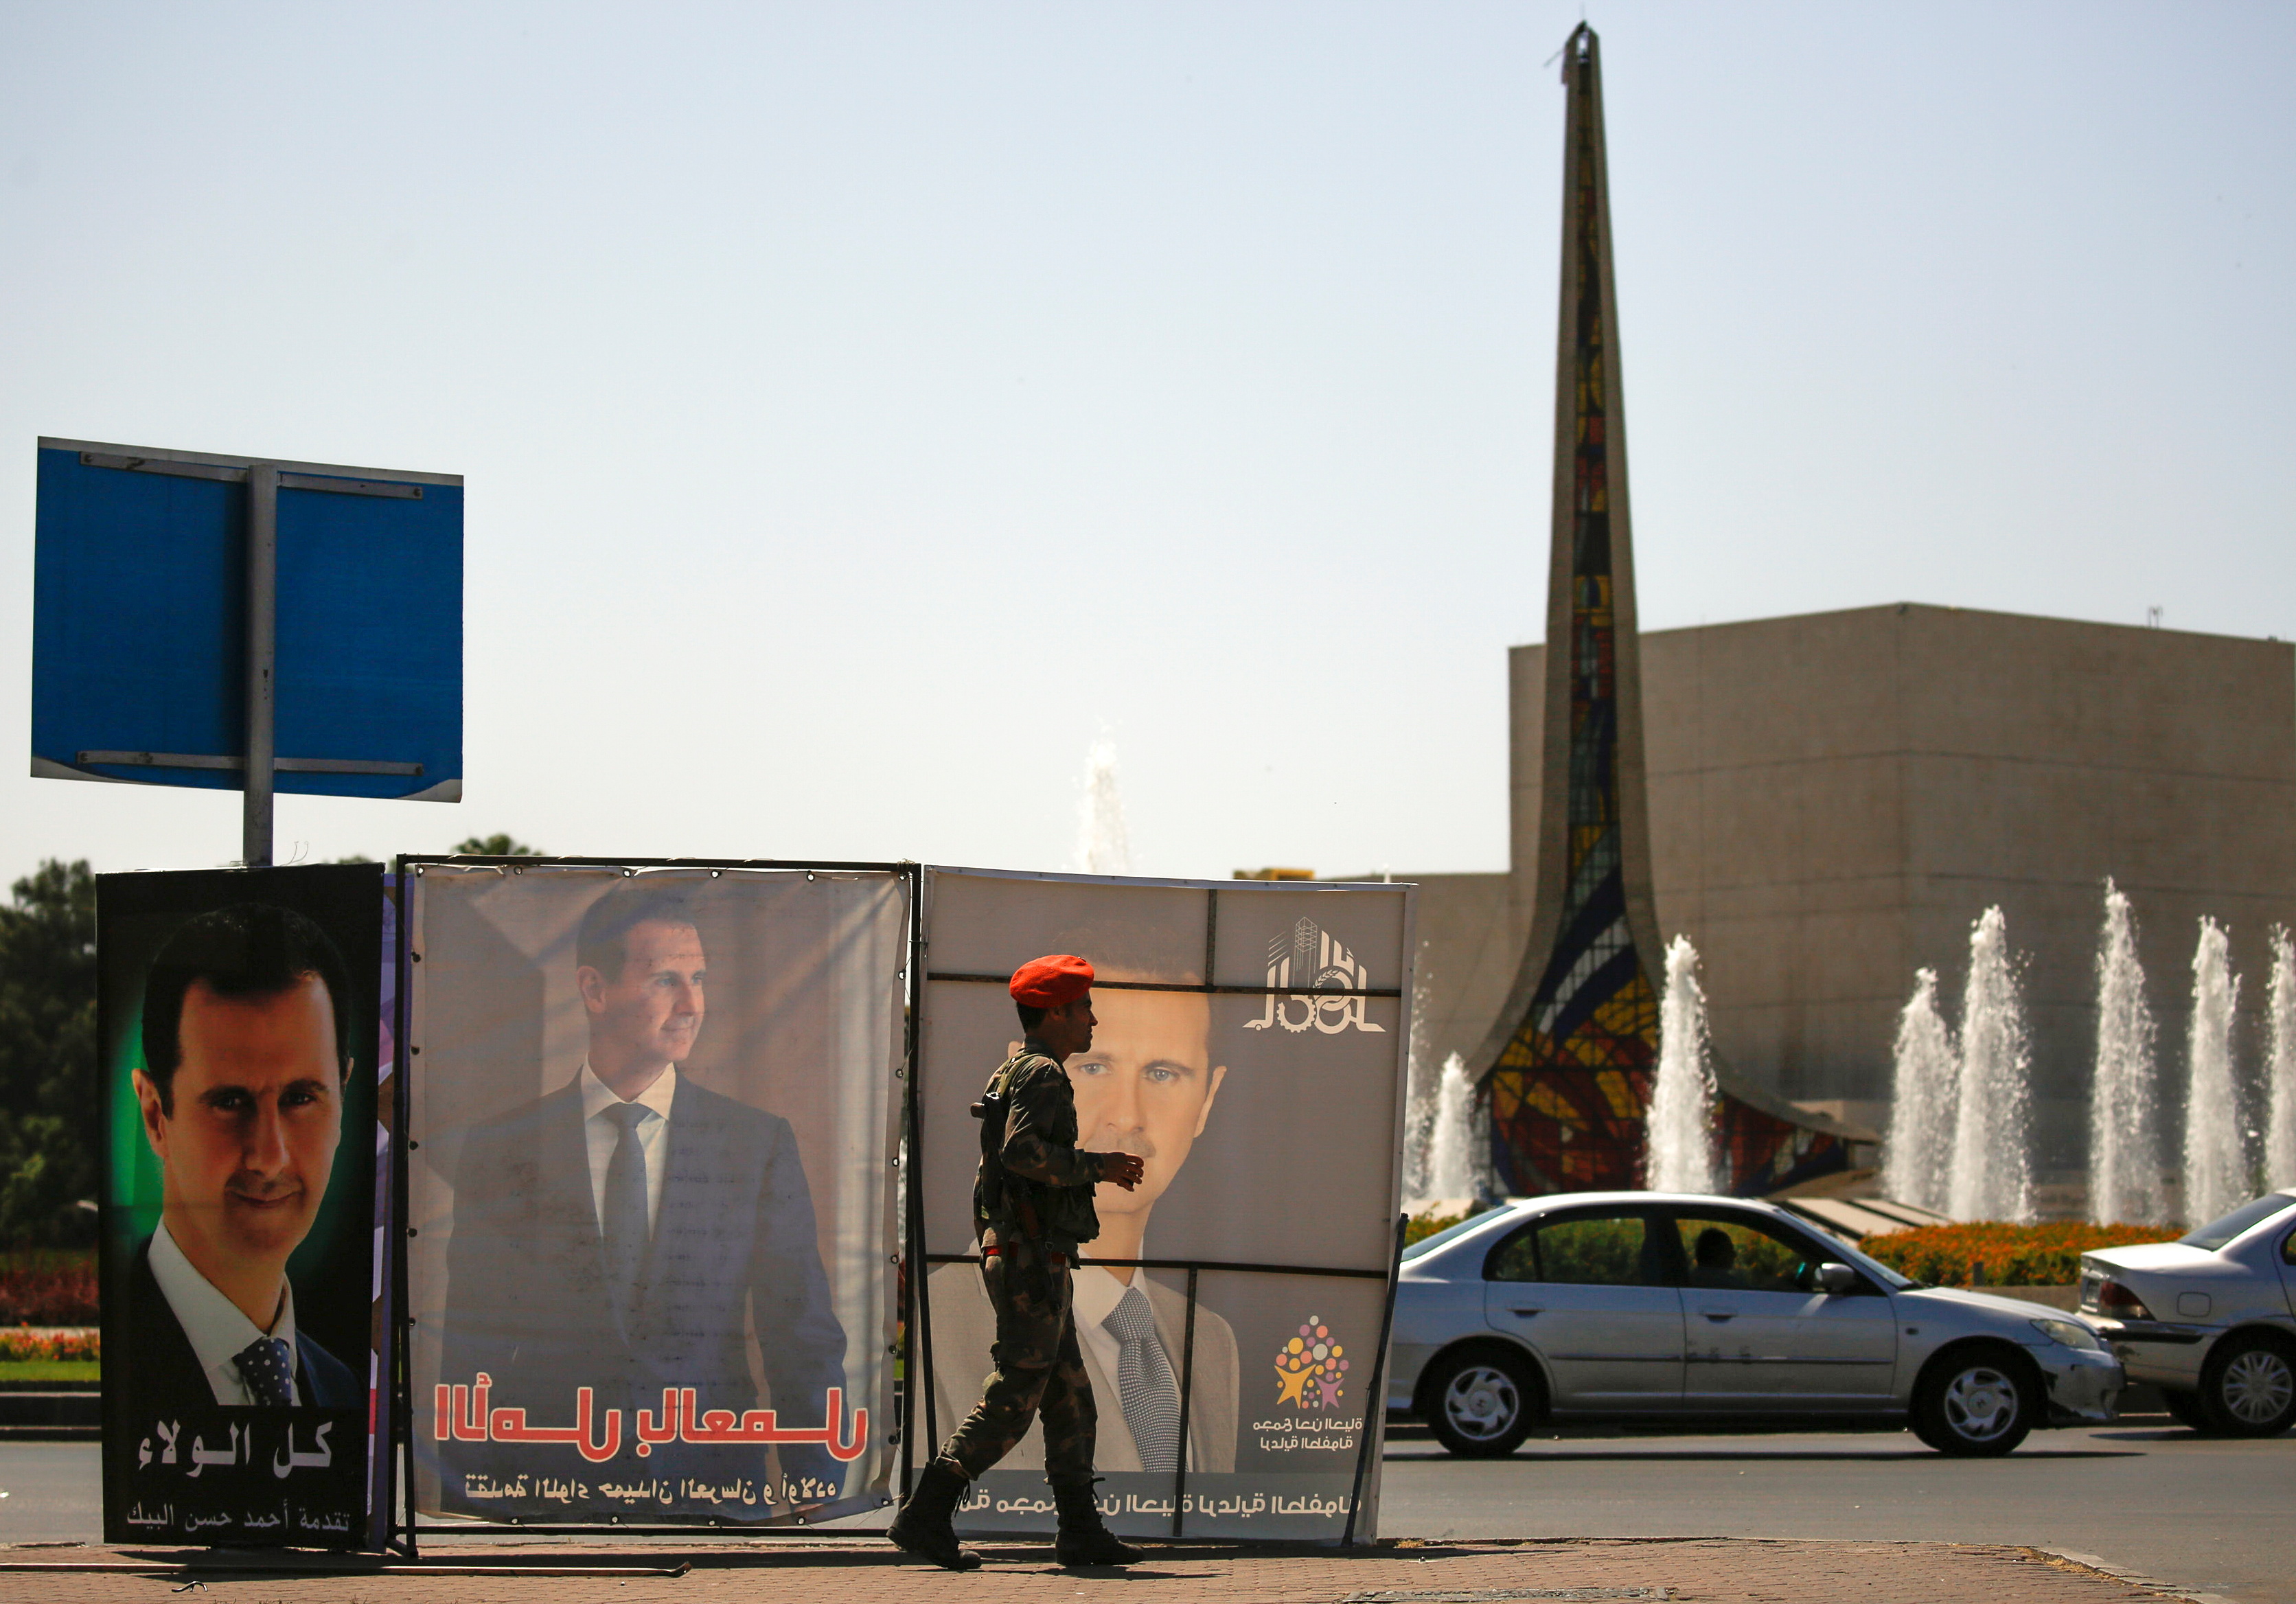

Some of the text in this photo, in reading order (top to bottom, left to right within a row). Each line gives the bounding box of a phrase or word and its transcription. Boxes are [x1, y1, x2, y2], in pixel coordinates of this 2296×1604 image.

[139, 1419, 333, 1478] كل الولاء
[127, 1498, 349, 1531] تقدمة أحمد حسن البيك
